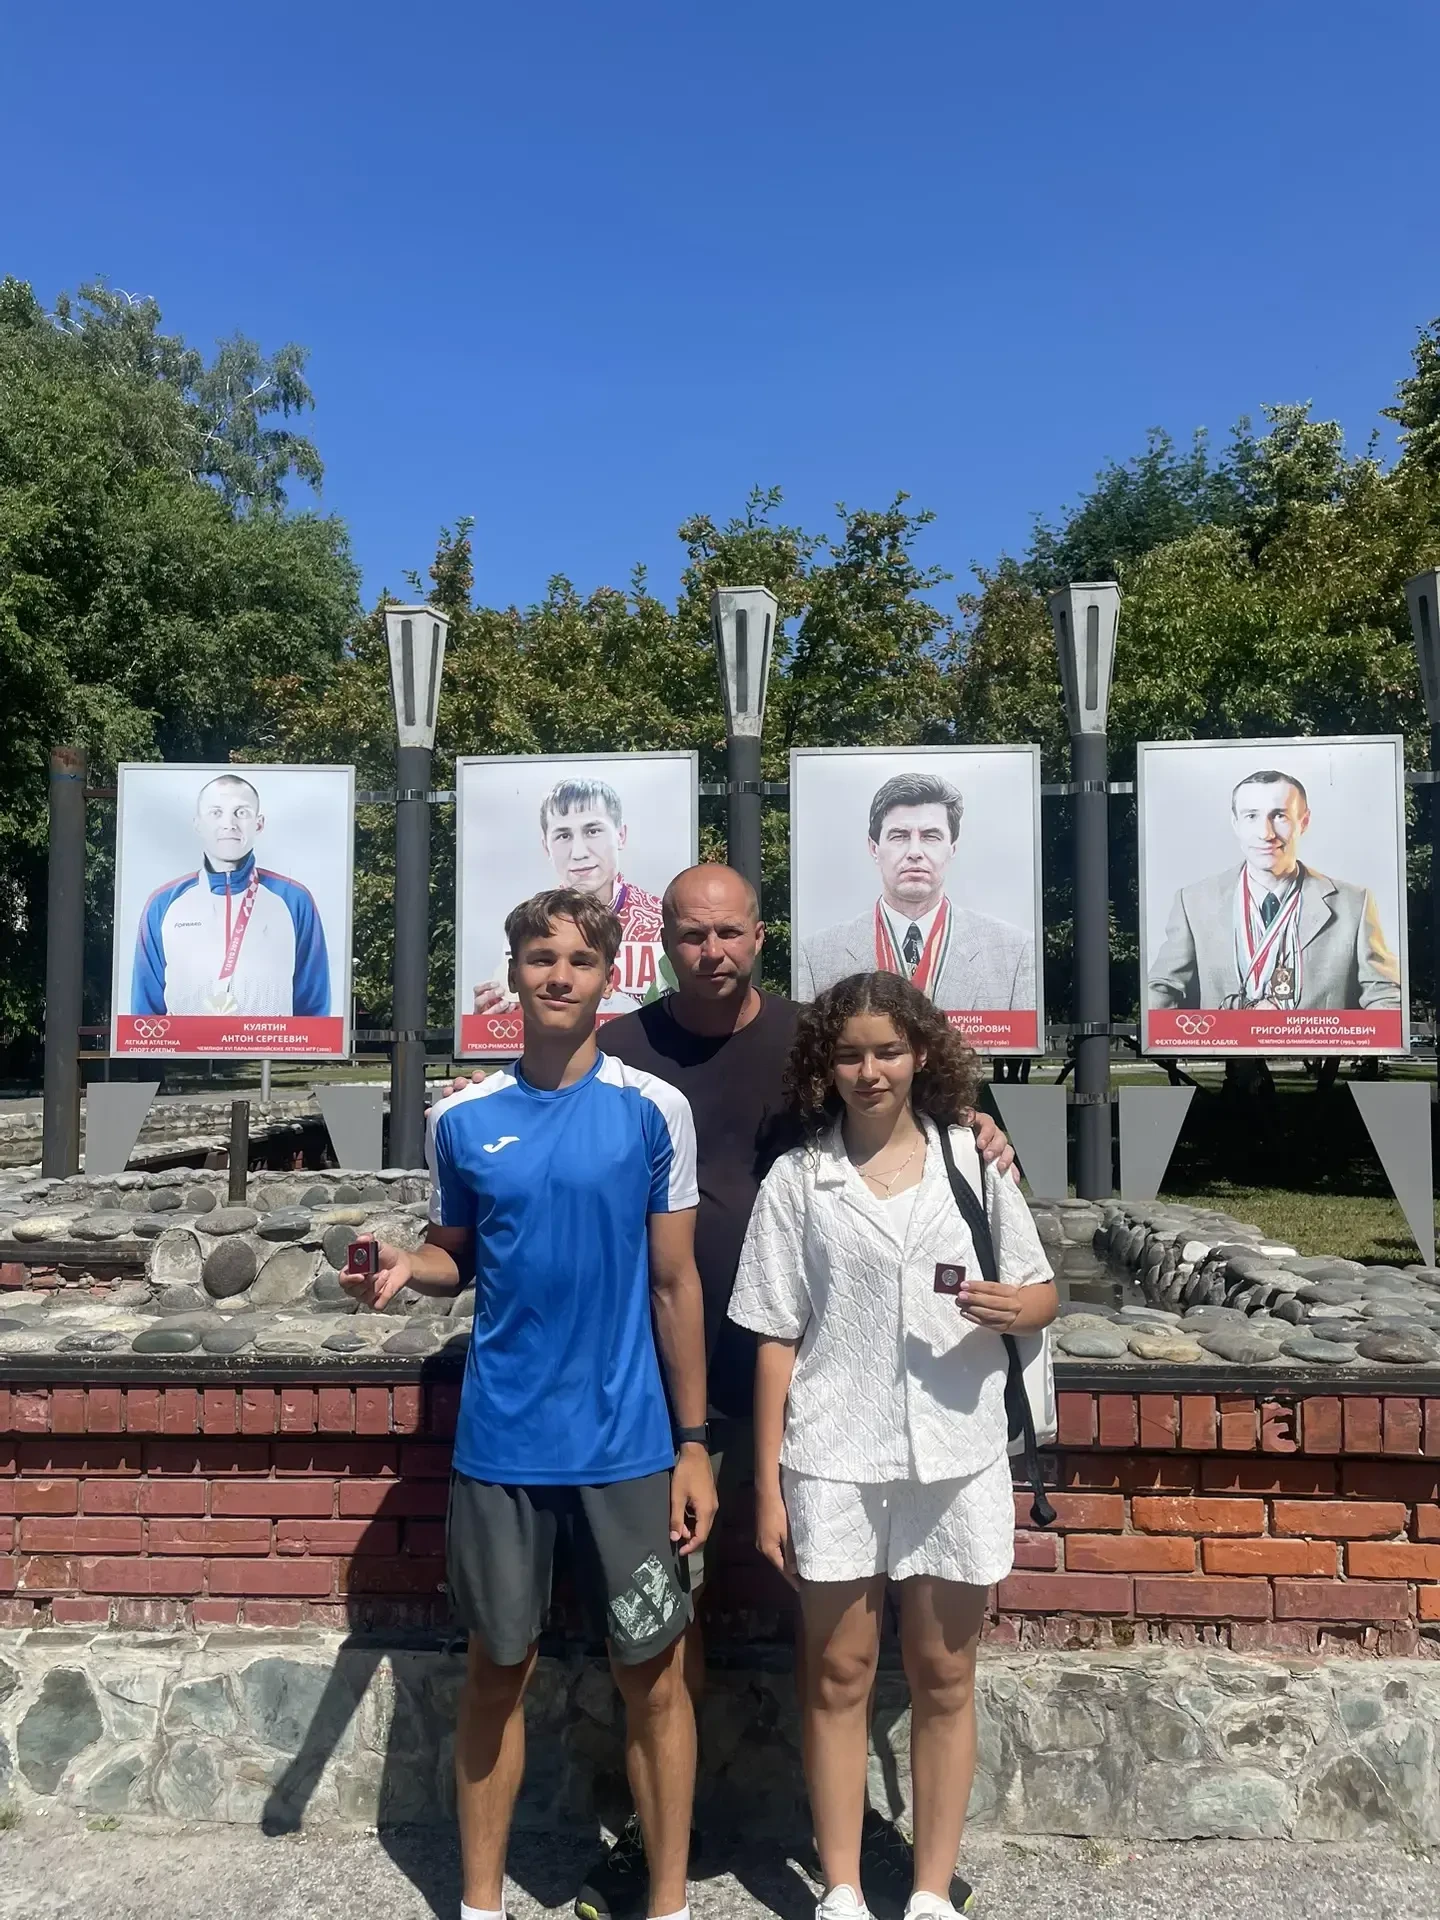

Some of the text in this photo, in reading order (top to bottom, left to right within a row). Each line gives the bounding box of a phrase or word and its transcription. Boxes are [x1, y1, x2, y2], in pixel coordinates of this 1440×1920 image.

[225, 951, 235, 971] TOKYO
[1286, 1017, 1340, 1025] КИРИЕНКО
[243, 1023, 287, 1031] КУЛЯТИН
[1250, 1025, 1376, 1035] ГРИГОРИЙ АНАТОЛЬЕВИЧ
[221, 1035, 309, 1043] АНТОН СЕРГЕЕВИЧ
